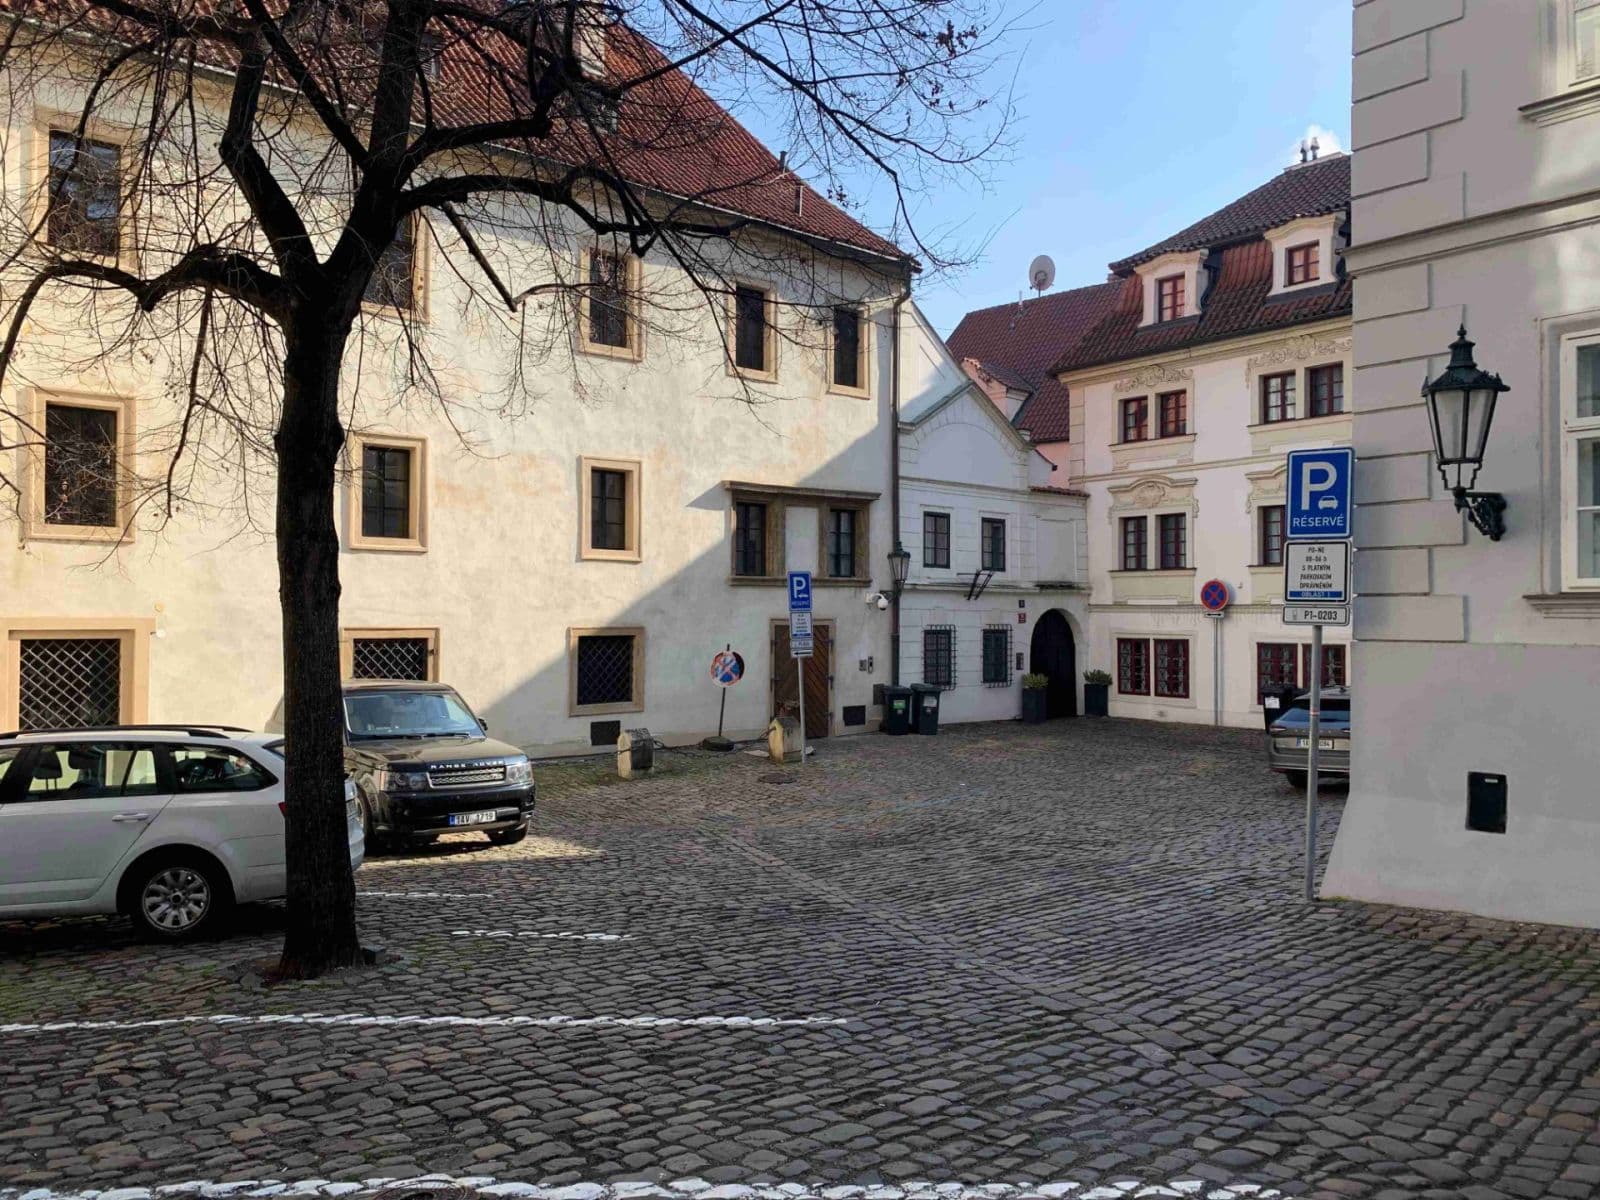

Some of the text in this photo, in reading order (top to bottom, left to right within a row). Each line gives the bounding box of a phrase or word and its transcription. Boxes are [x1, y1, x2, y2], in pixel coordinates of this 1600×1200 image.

[1301, 461, 1337, 511] P
[1292, 514, 1345, 528] RÉSERVÉ
[1308, 546, 1325, 554] PO-NE
[793, 576, 807, 599] P
[1304, 610, 1338, 621] P1-0203
